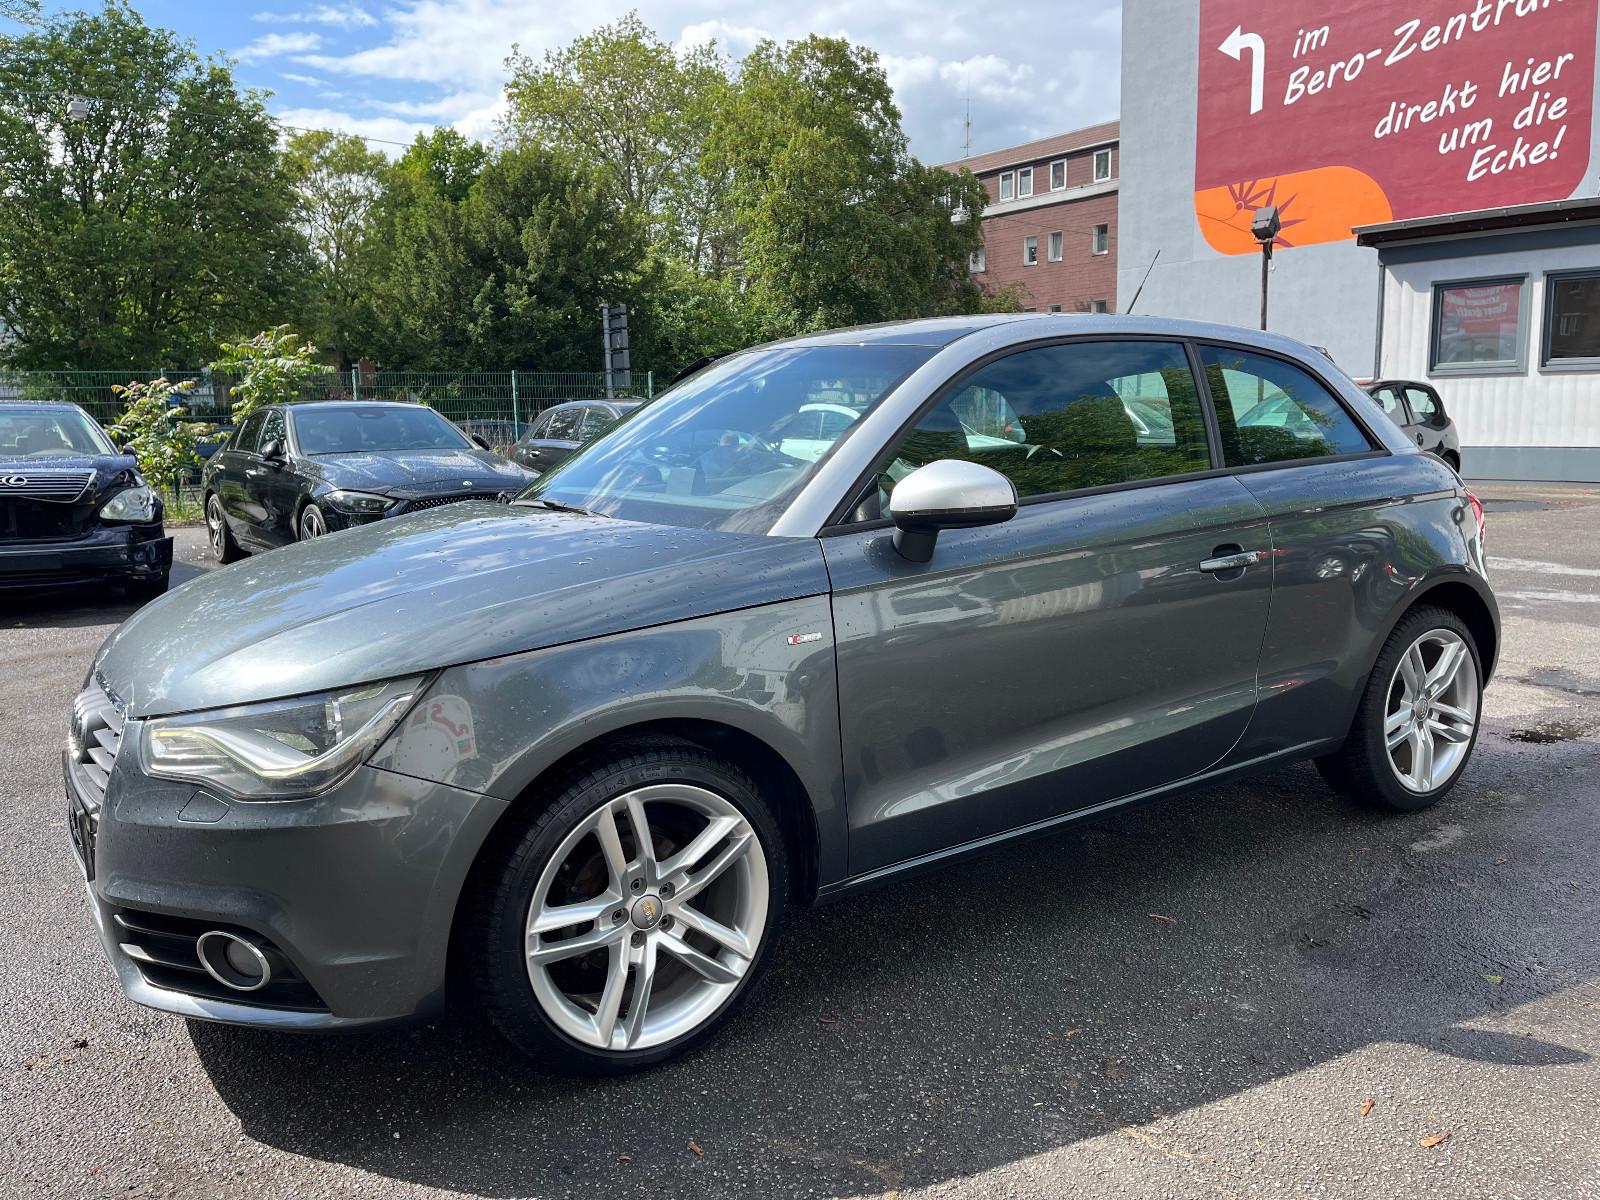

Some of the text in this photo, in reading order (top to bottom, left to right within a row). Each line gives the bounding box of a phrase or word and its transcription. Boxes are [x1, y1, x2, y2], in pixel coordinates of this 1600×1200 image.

[1283, 0, 1563, 106] Bero-Zentru
[1292, 25, 1330, 59] im
[1374, 53, 1574, 139] direkt hier
[1438, 91, 1567, 155] um die
[1466, 125, 1567, 182] Ecke!
